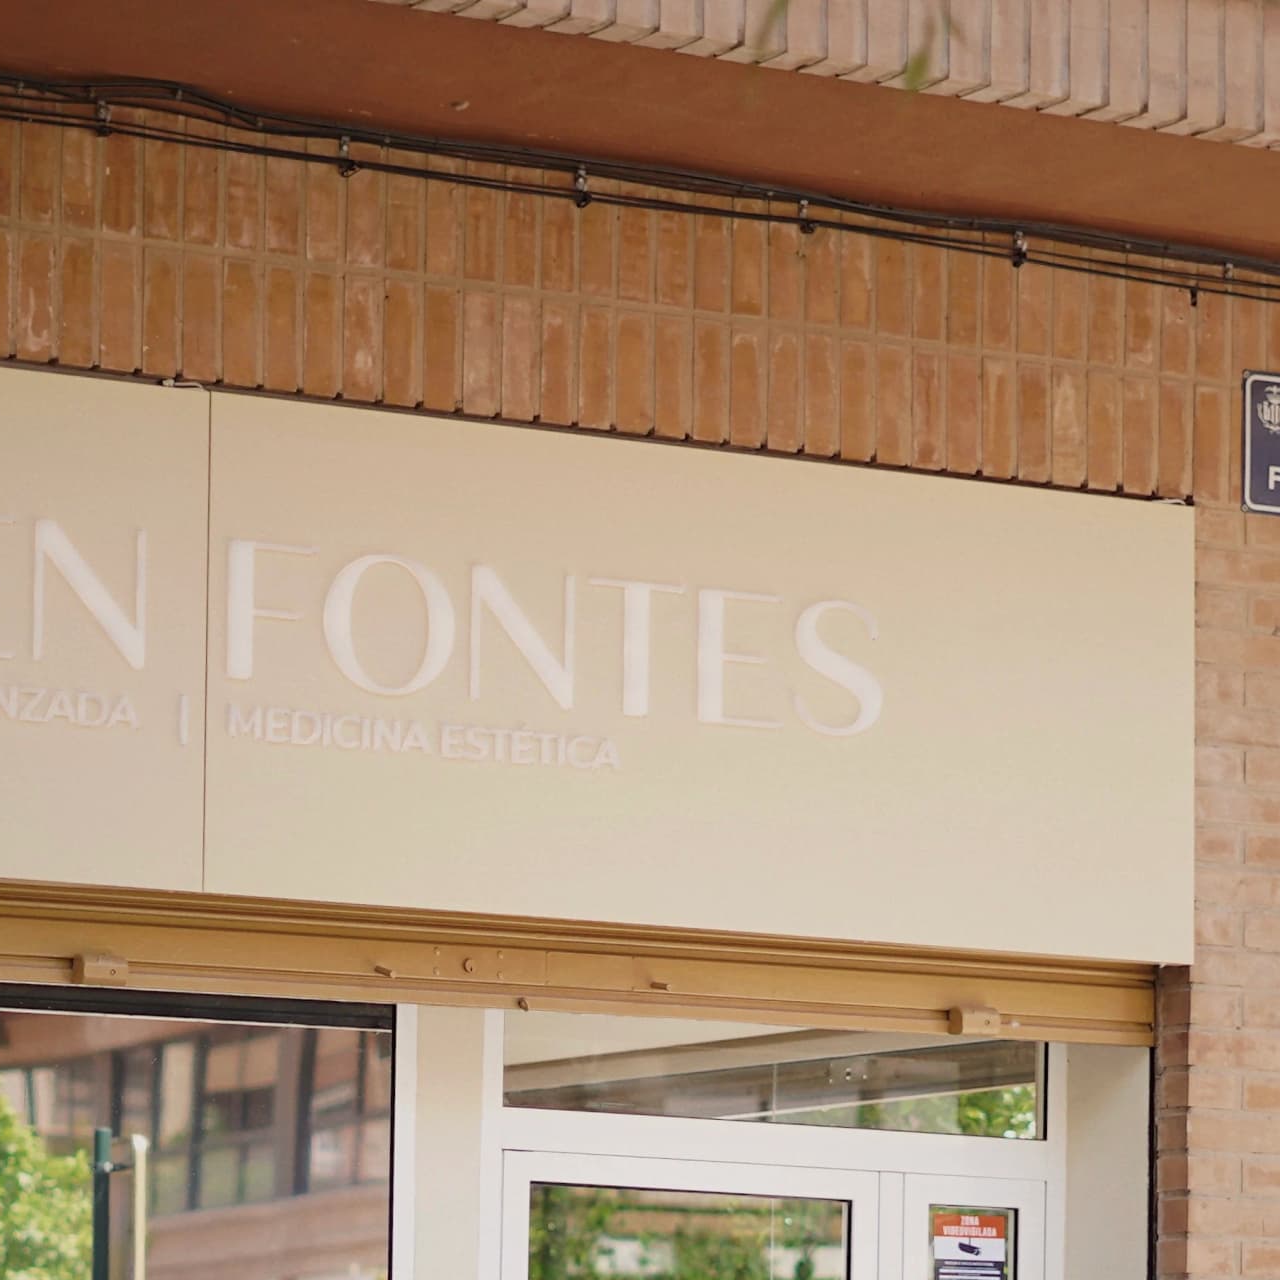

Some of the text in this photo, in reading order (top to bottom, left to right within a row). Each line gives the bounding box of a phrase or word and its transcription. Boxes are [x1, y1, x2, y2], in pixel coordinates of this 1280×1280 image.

[225, 538, 885, 738] FONTES
[228, 703, 432, 753] MEDICINA
[440, 721, 622, 770] ESTÉTICA
